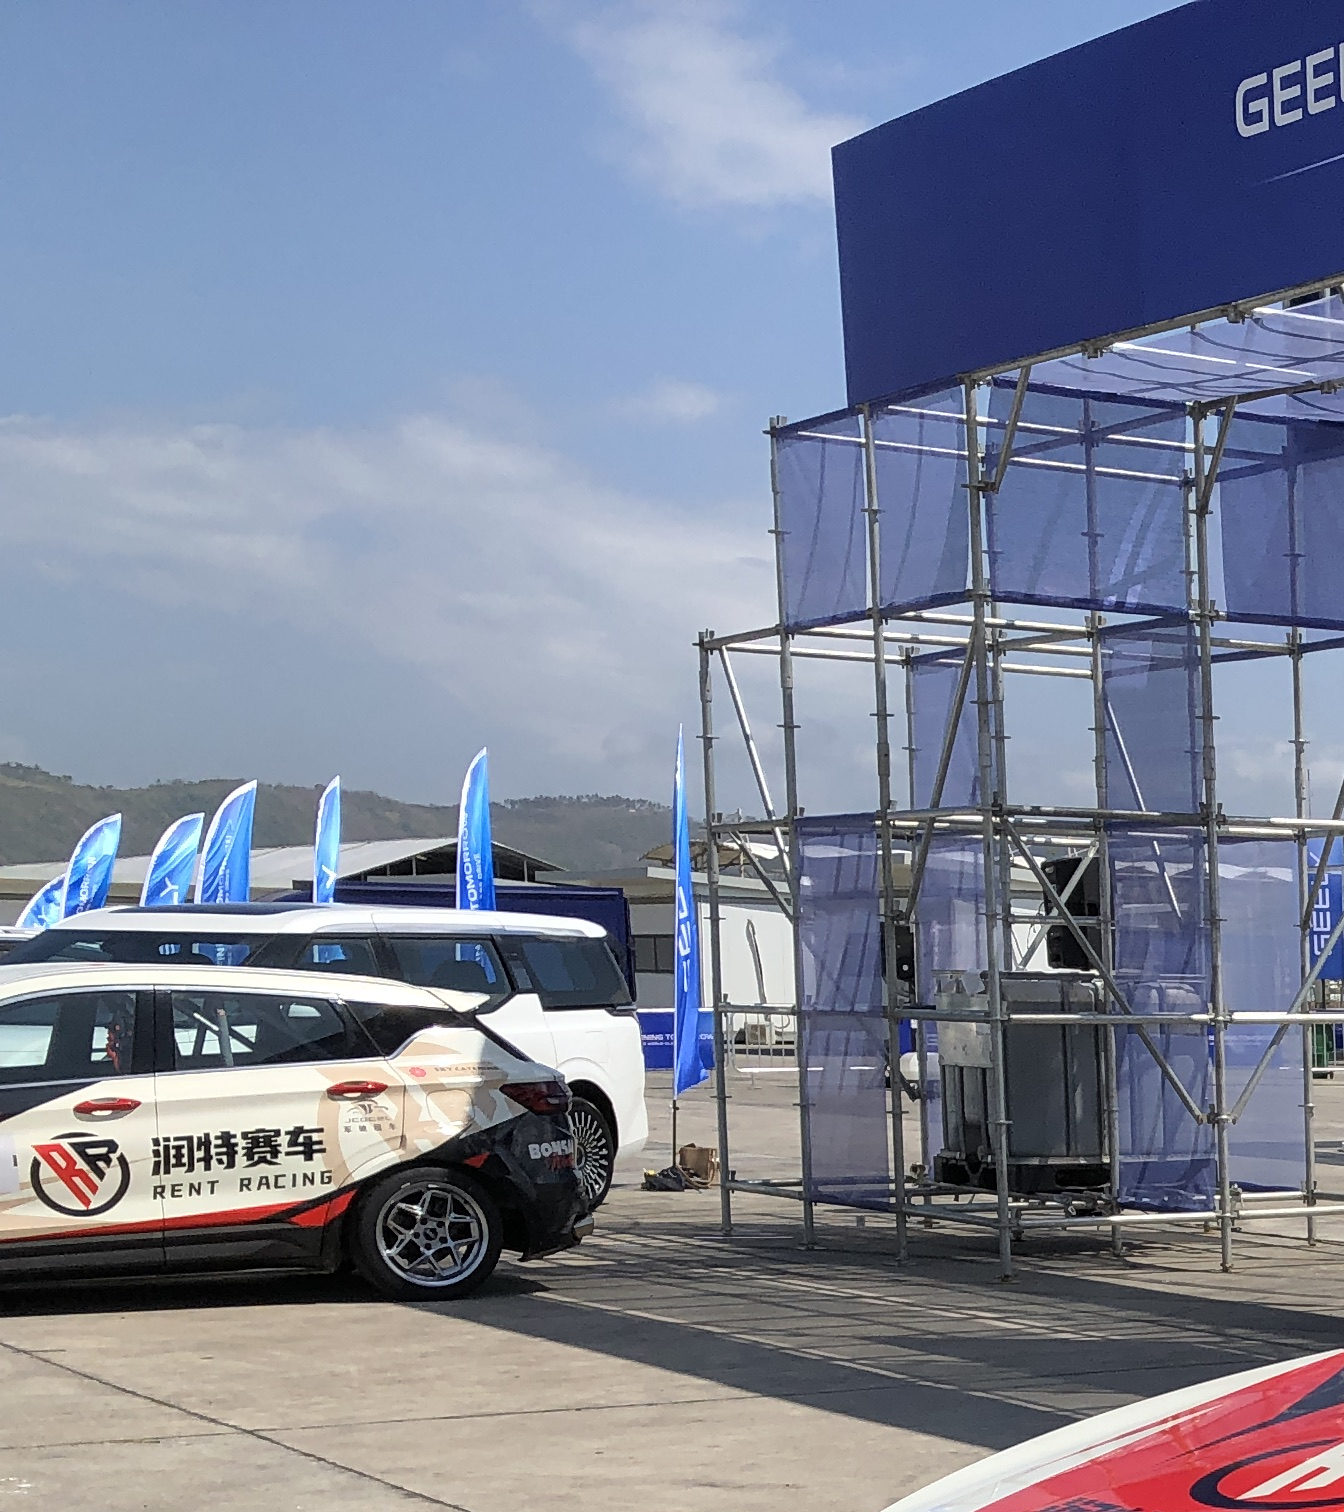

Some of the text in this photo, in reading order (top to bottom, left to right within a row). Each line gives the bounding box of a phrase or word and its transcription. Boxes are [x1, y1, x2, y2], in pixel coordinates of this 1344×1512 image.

[150, 1125, 327, 1177] 润特赛车
[152, 1169, 334, 1201] RENT RACING
